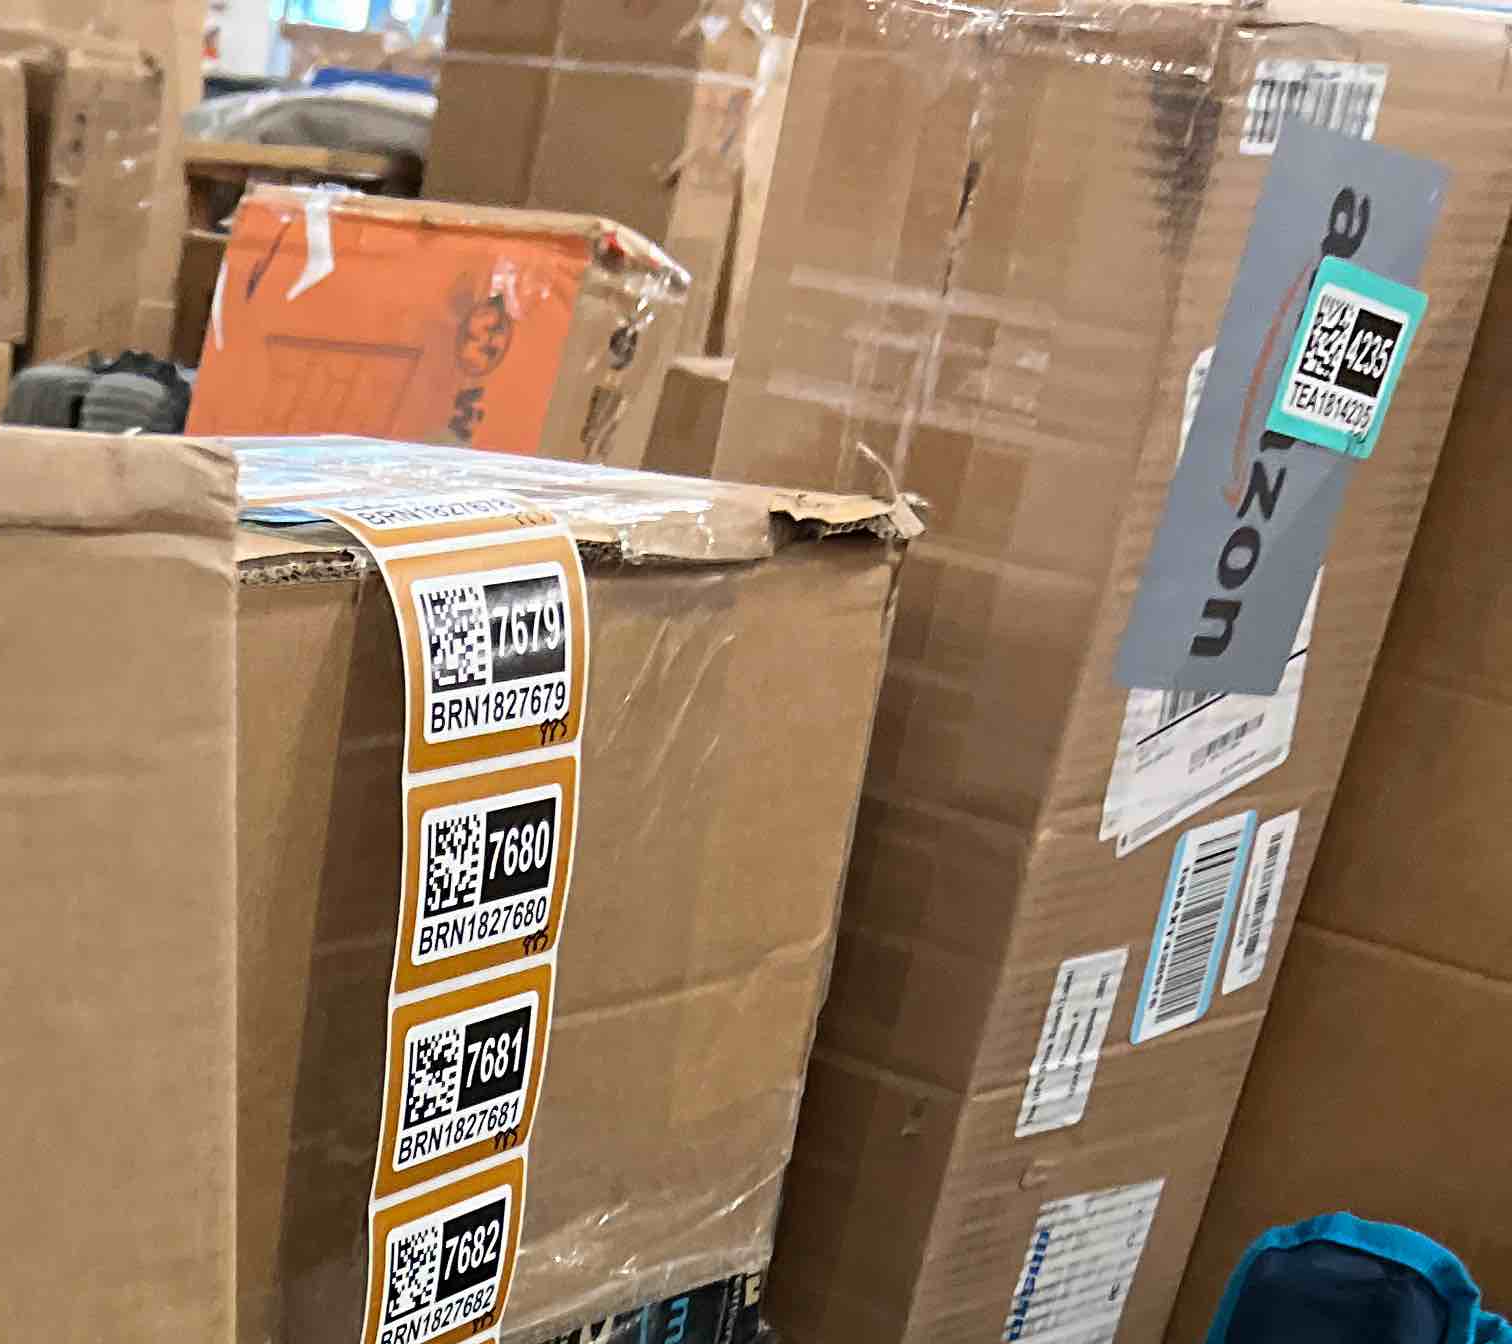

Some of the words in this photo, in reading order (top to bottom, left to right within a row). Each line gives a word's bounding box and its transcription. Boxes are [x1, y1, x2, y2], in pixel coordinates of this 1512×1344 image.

[1344, 329, 1393, 378] 4235
[1189, 186, 1371, 656] azon
[490, 591, 561, 657] 7679
[431, 681, 566, 734] BRN1827679
[489, 820, 550, 880] 7680
[419, 896, 547, 955] BRN1827680
[465, 1027, 524, 1088] 7681
[398, 1099, 520, 1165] BRN1827681
[444, 1219, 500, 1281] 7682
